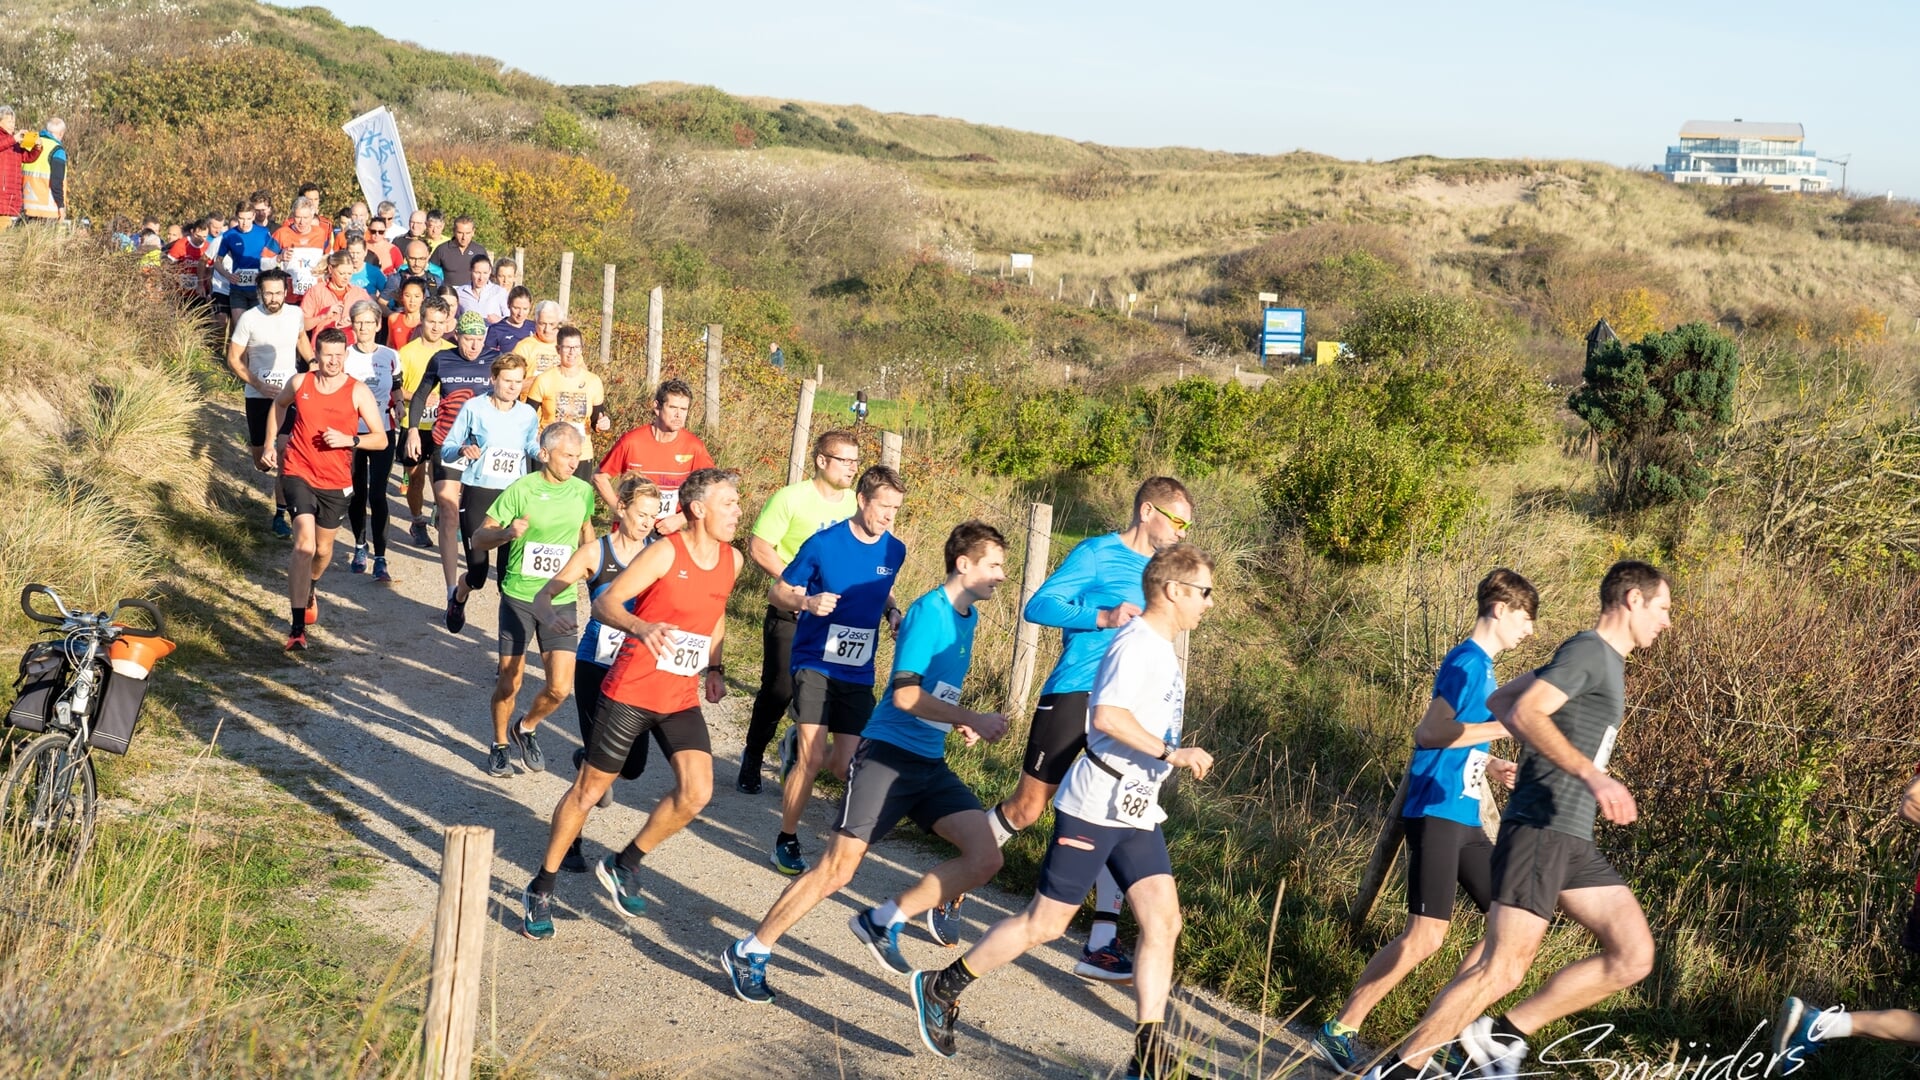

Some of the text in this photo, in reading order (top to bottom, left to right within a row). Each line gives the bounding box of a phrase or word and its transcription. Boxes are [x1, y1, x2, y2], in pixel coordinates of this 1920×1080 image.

[492, 458, 515, 473] 845
[543, 547, 565, 556] asics
[533, 556, 561, 573] 839
[687, 637, 706, 649] asics
[848, 631, 870, 641] asics
[837, 640, 866, 659] 877
[673, 647, 700, 669] 870
[1121, 793, 1149, 818] 888
